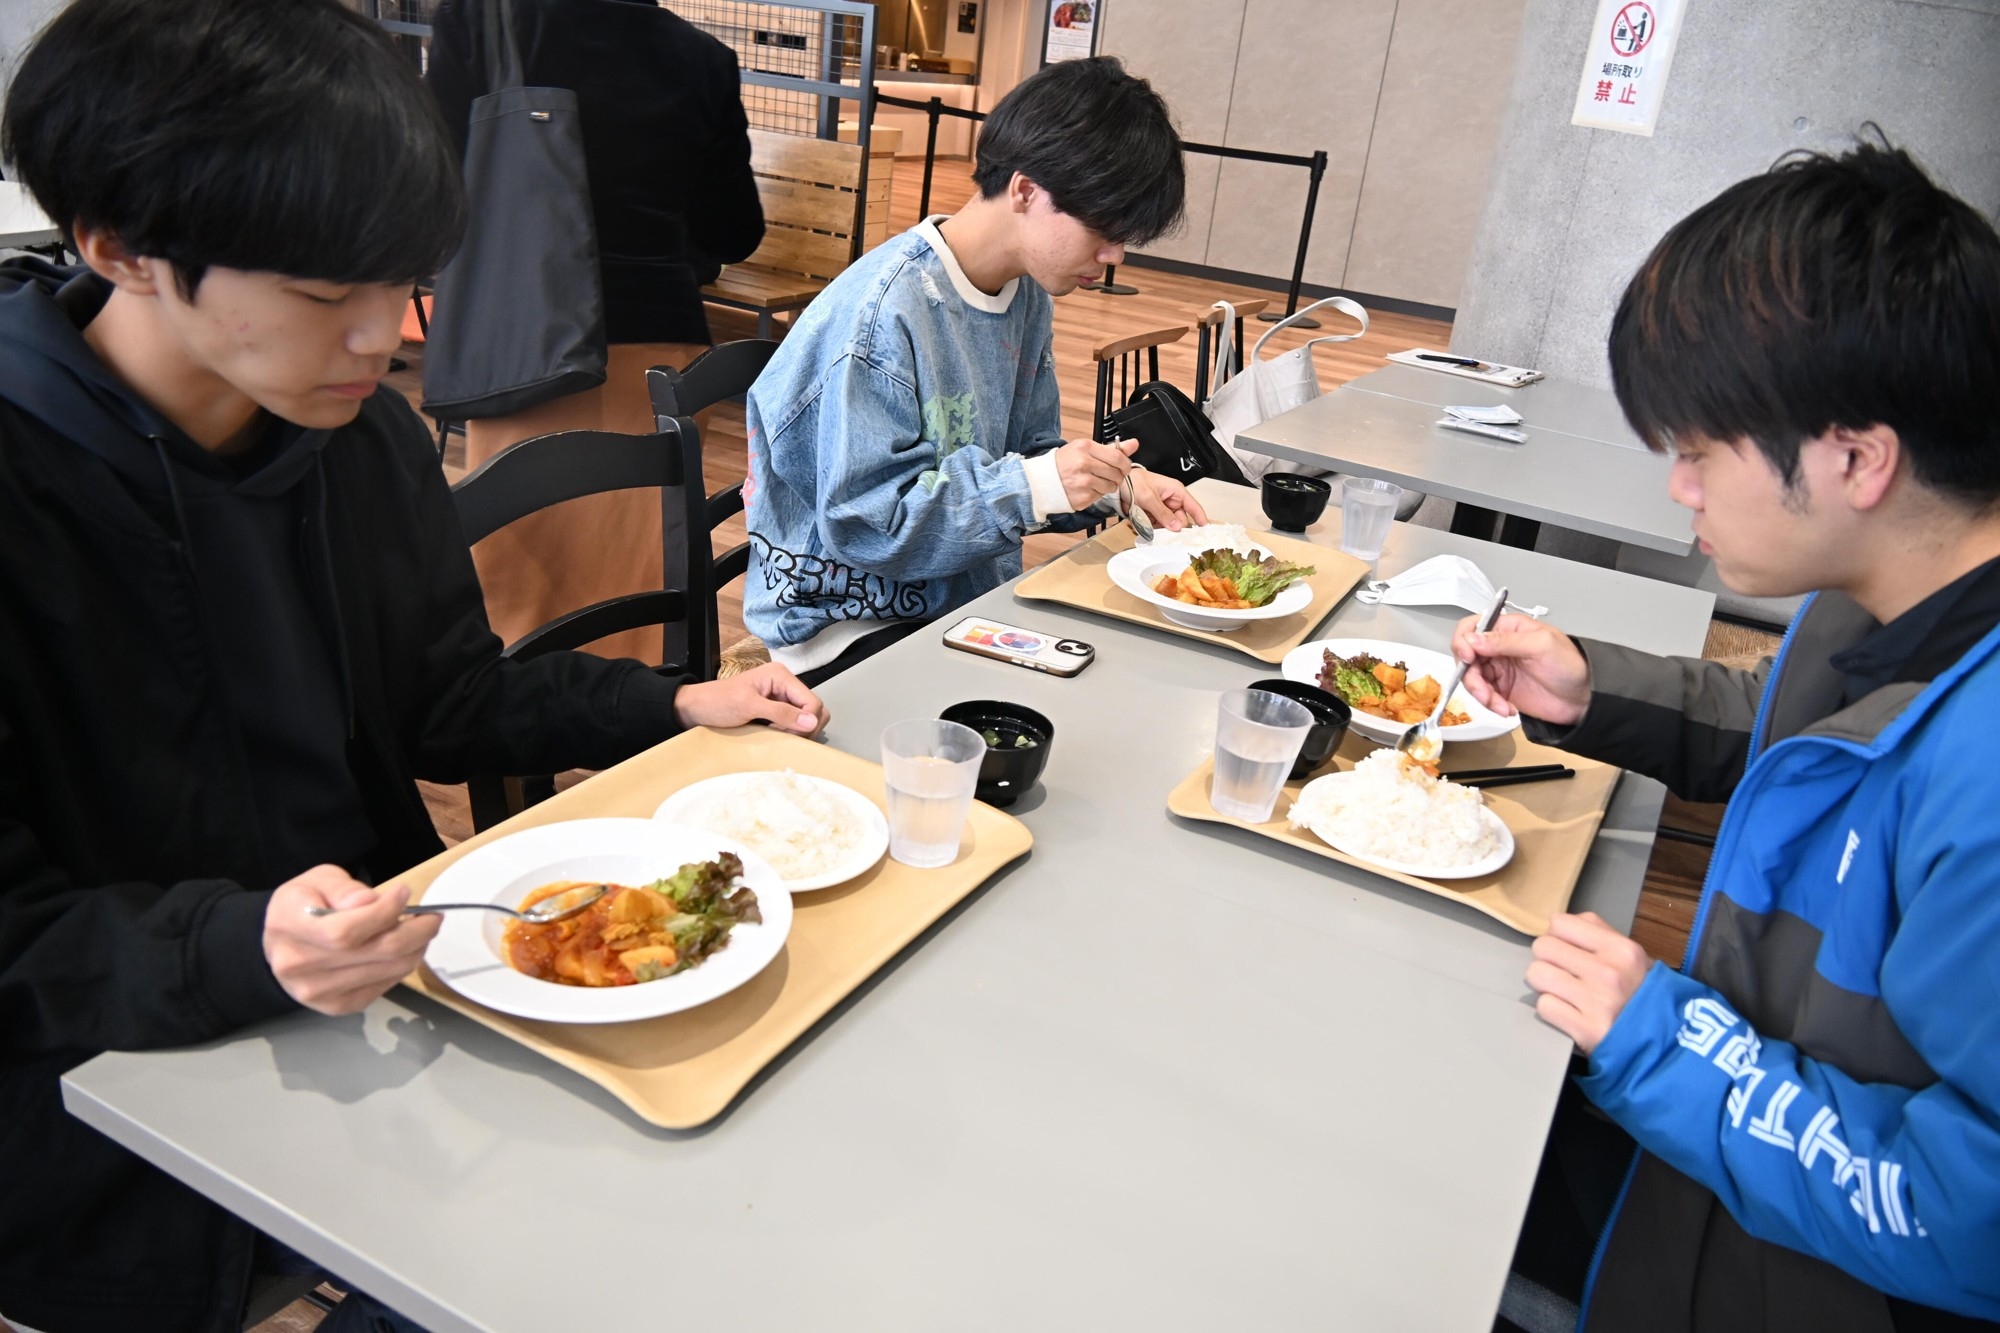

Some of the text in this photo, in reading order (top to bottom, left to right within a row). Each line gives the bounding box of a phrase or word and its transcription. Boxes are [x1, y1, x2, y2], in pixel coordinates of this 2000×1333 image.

[1602, 62, 1642, 78] 場所取り
[1594, 80, 1637, 105] 禁止
[1676, 998, 1927, 1237] IGHTERS
